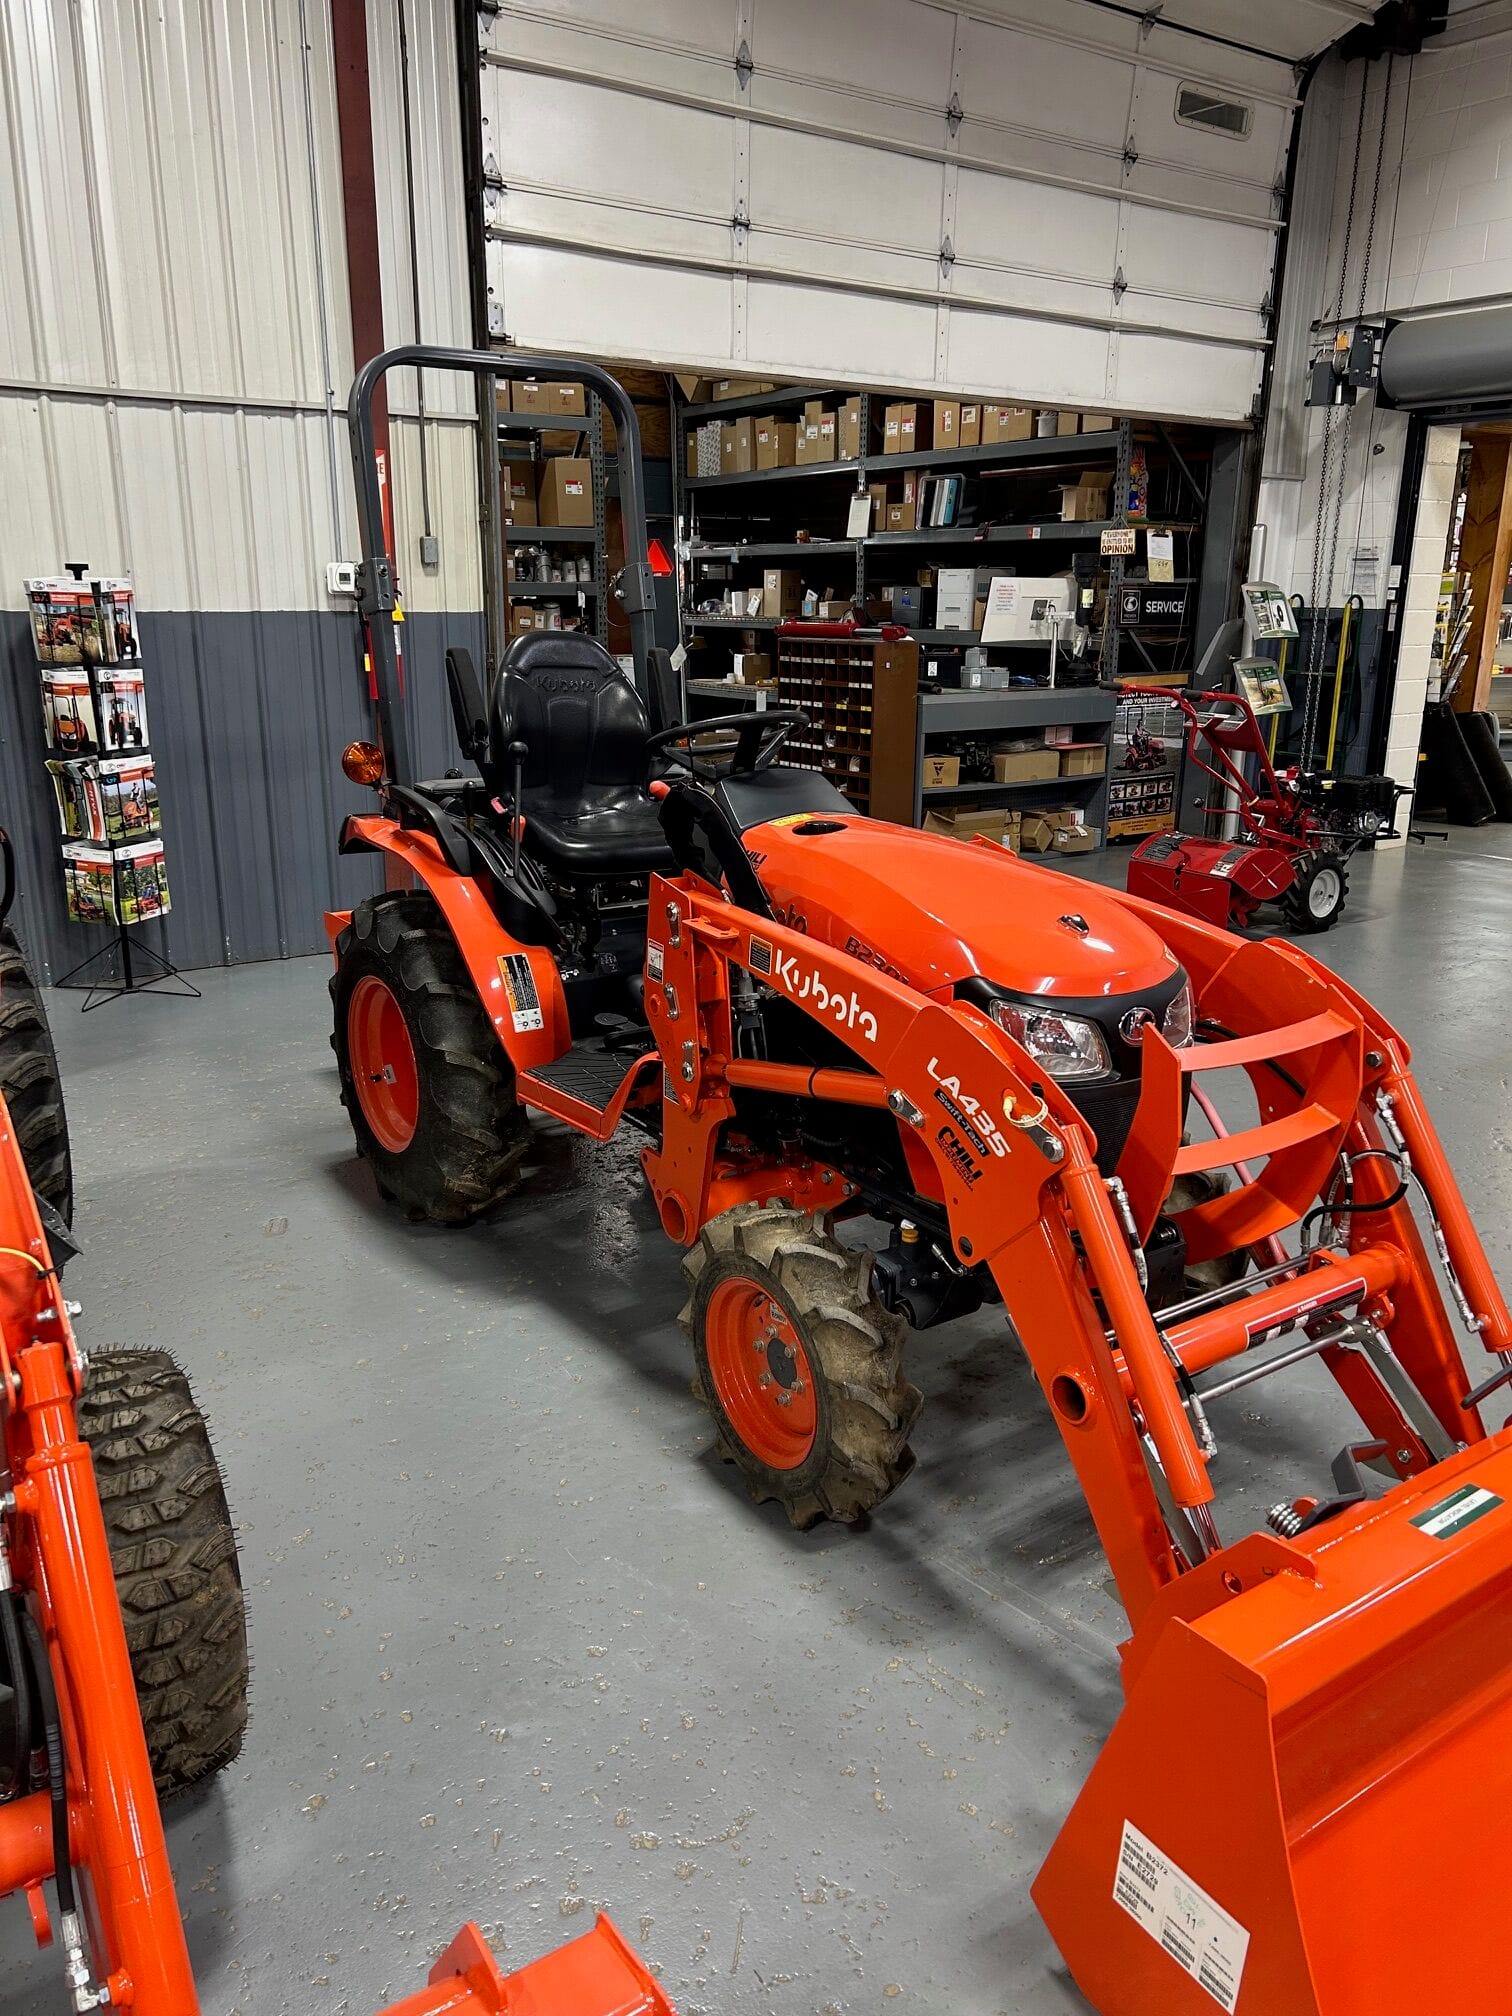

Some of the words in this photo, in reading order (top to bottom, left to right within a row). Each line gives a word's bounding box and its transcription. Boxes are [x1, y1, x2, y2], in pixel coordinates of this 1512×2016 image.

[1101, 545, 1134, 554] OPINION
[1145, 600, 1184, 613] SERVICE
[536, 674, 598, 693] Kubota
[773, 903, 808, 935] ota
[775, 949, 878, 1043] Kubota
[927, 1056, 1012, 1158] LA435
[937, 1091, 987, 1155] Swift-Tach
[938, 1125, 983, 1181] CHILI
[1125, 1832, 1144, 1852] Model
